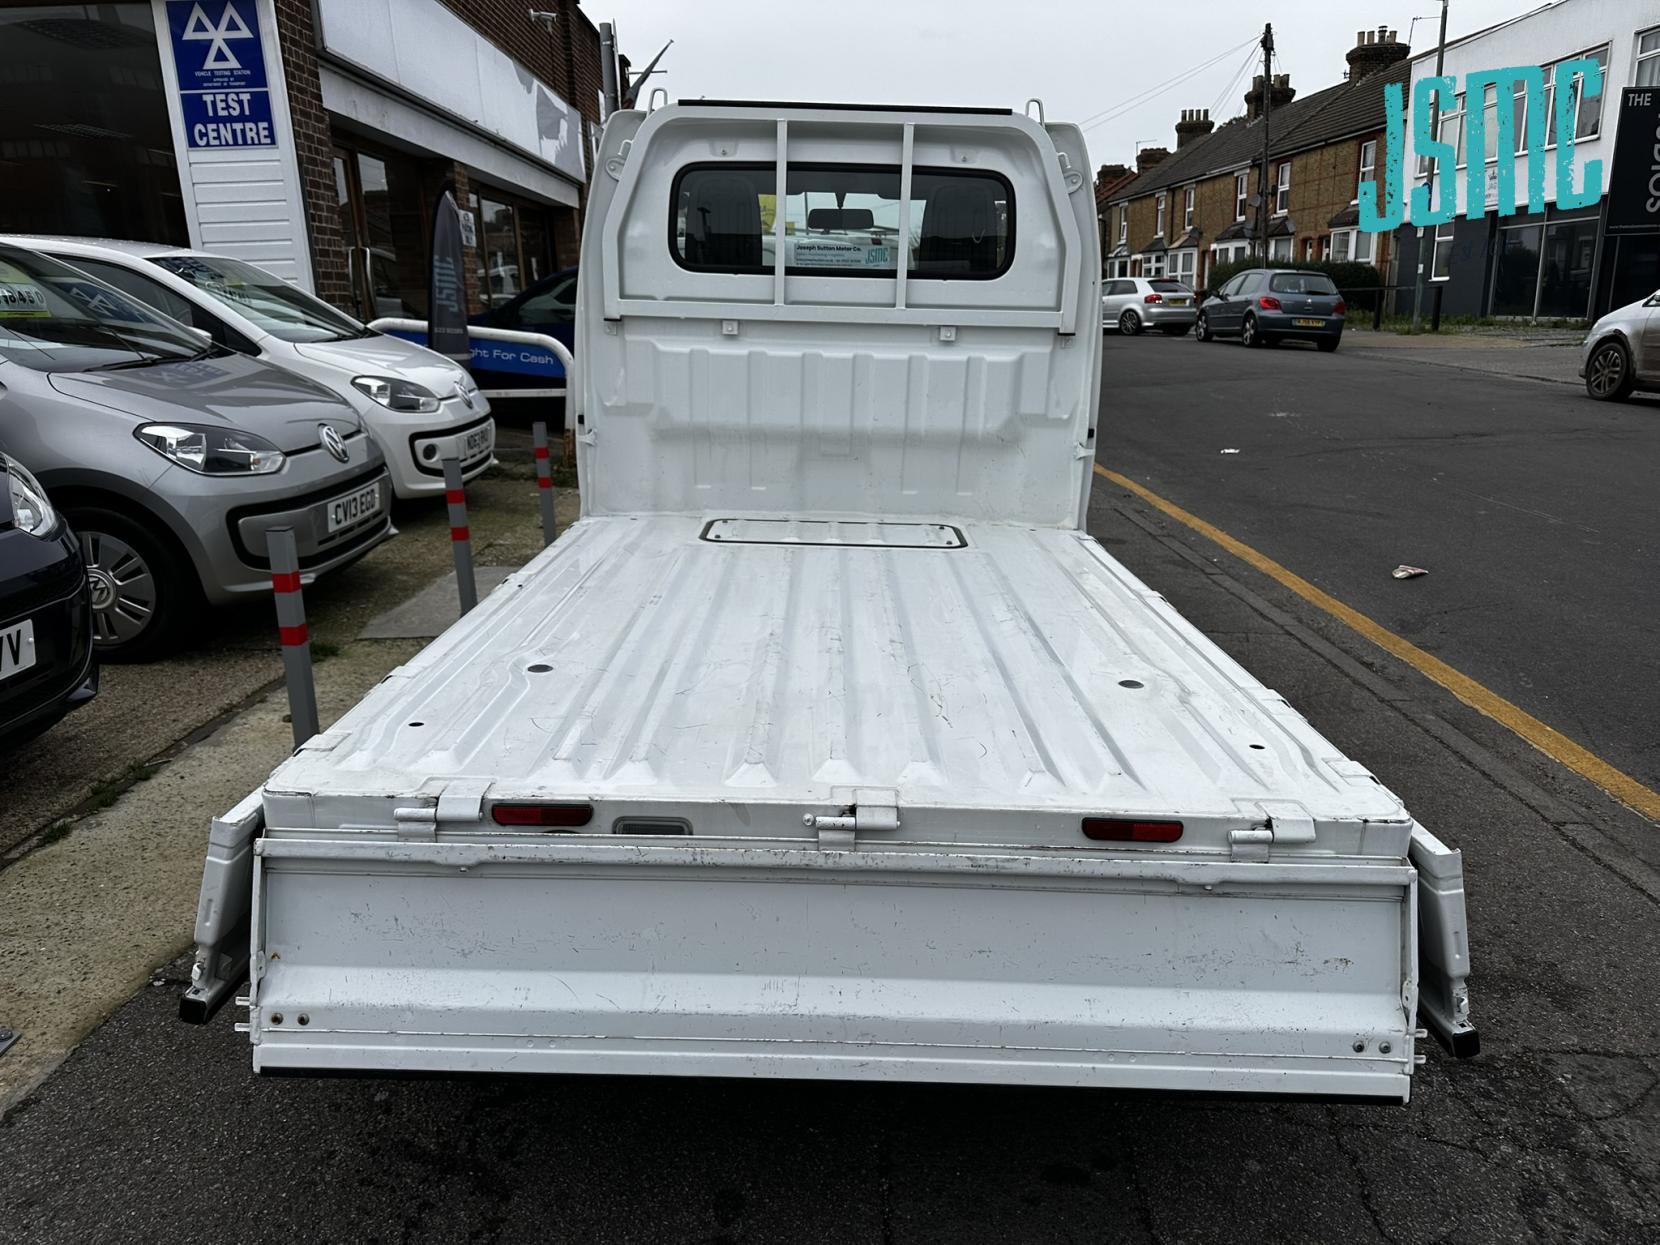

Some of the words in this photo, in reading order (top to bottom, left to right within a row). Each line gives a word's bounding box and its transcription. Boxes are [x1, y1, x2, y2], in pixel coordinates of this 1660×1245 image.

[202, 93, 251, 117] TEST
[1628, 93, 1652, 107] THE
[193, 122, 271, 146] CENTRE
[493, 349, 516, 361] For
[520, 352, 554, 365] Cash
[335, 497, 358, 525] CV13
[0, 629, 21, 674] V
